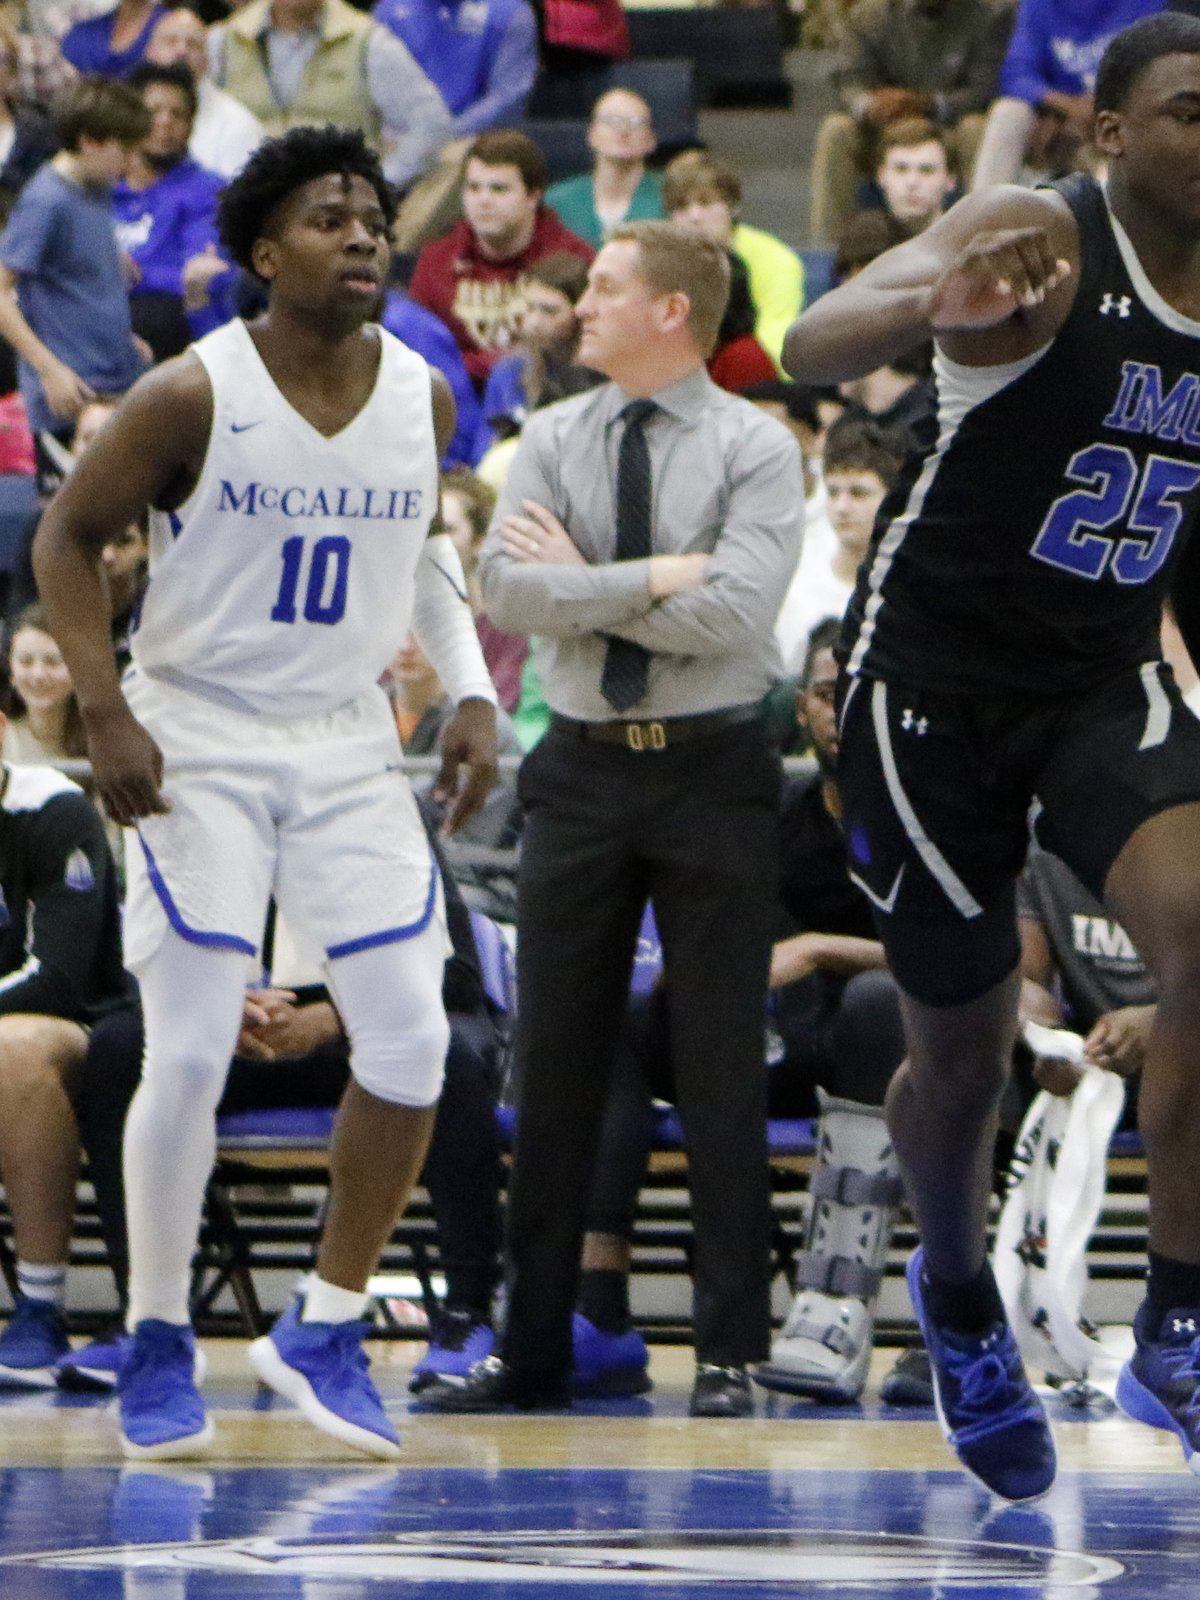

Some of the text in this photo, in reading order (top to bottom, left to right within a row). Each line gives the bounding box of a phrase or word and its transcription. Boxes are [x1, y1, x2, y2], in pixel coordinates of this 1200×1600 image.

[217, 479, 423, 519] McCALLIE
[270, 535, 351, 625] 10
[1072, 914, 1137, 960] IM
